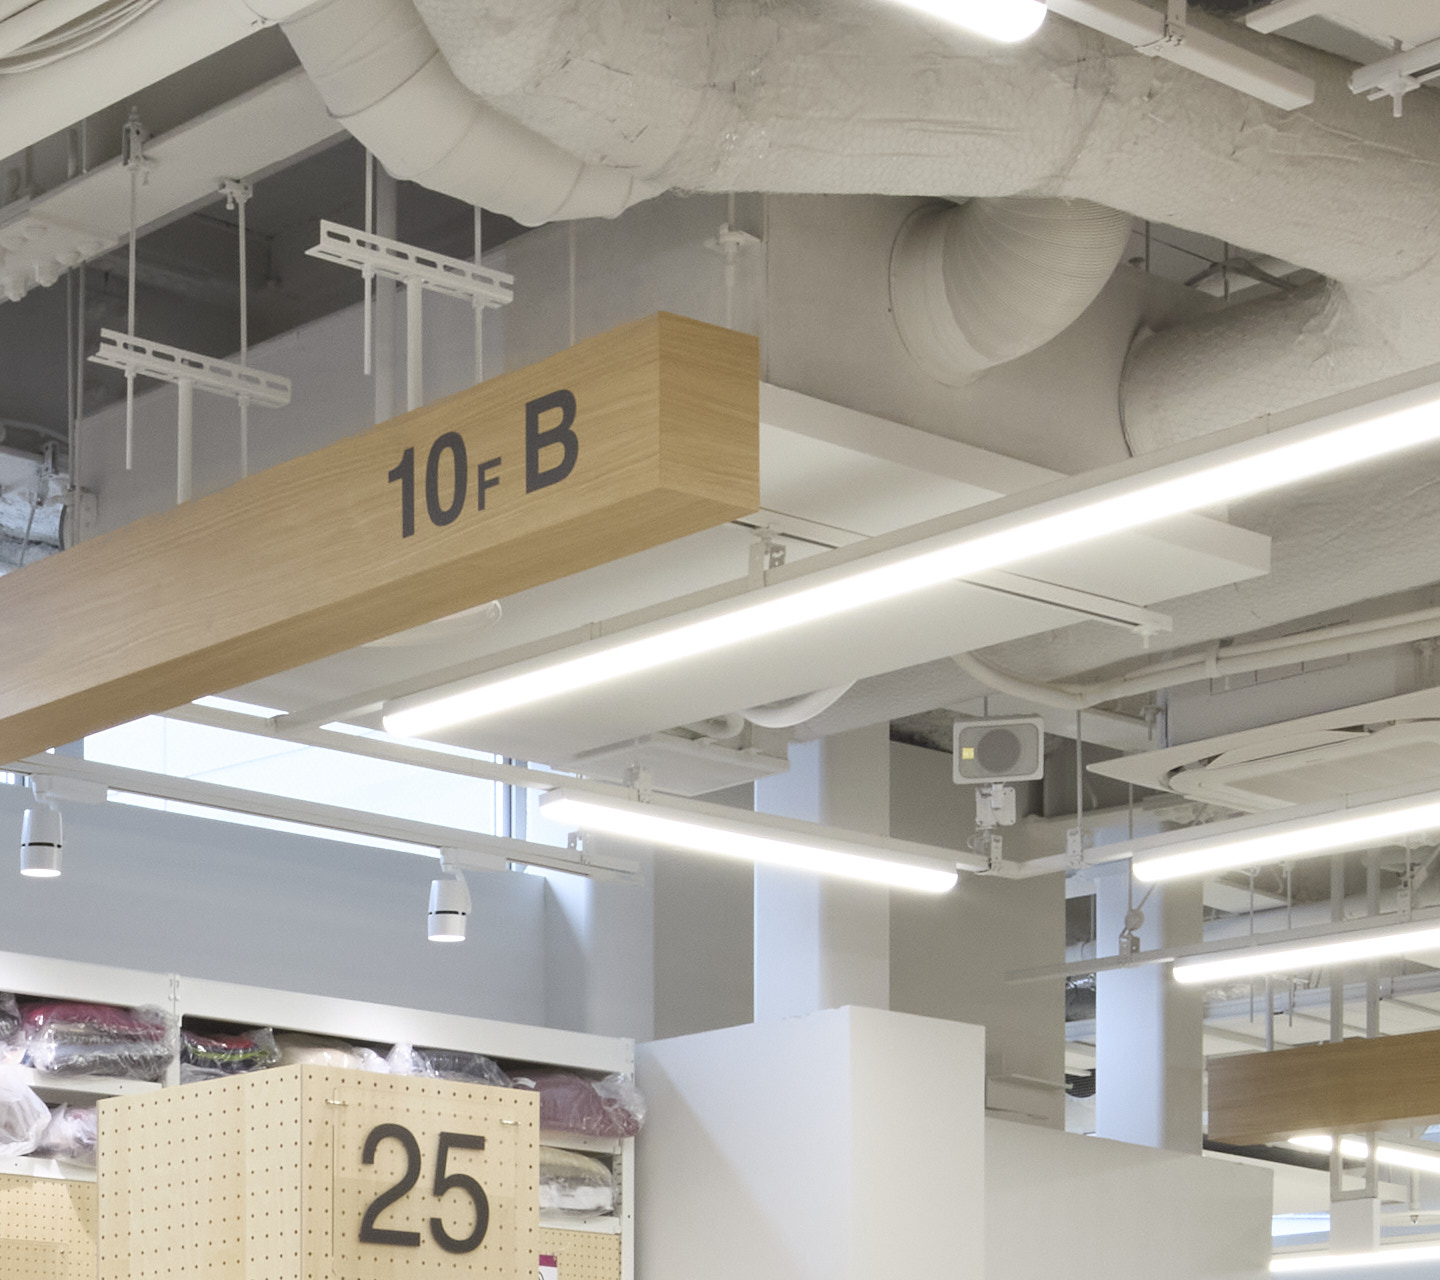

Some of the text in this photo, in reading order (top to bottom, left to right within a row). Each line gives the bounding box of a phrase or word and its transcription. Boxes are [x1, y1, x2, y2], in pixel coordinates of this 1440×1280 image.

[387, 389, 580, 539] 10F B
[358, 1122, 490, 1254] 25
